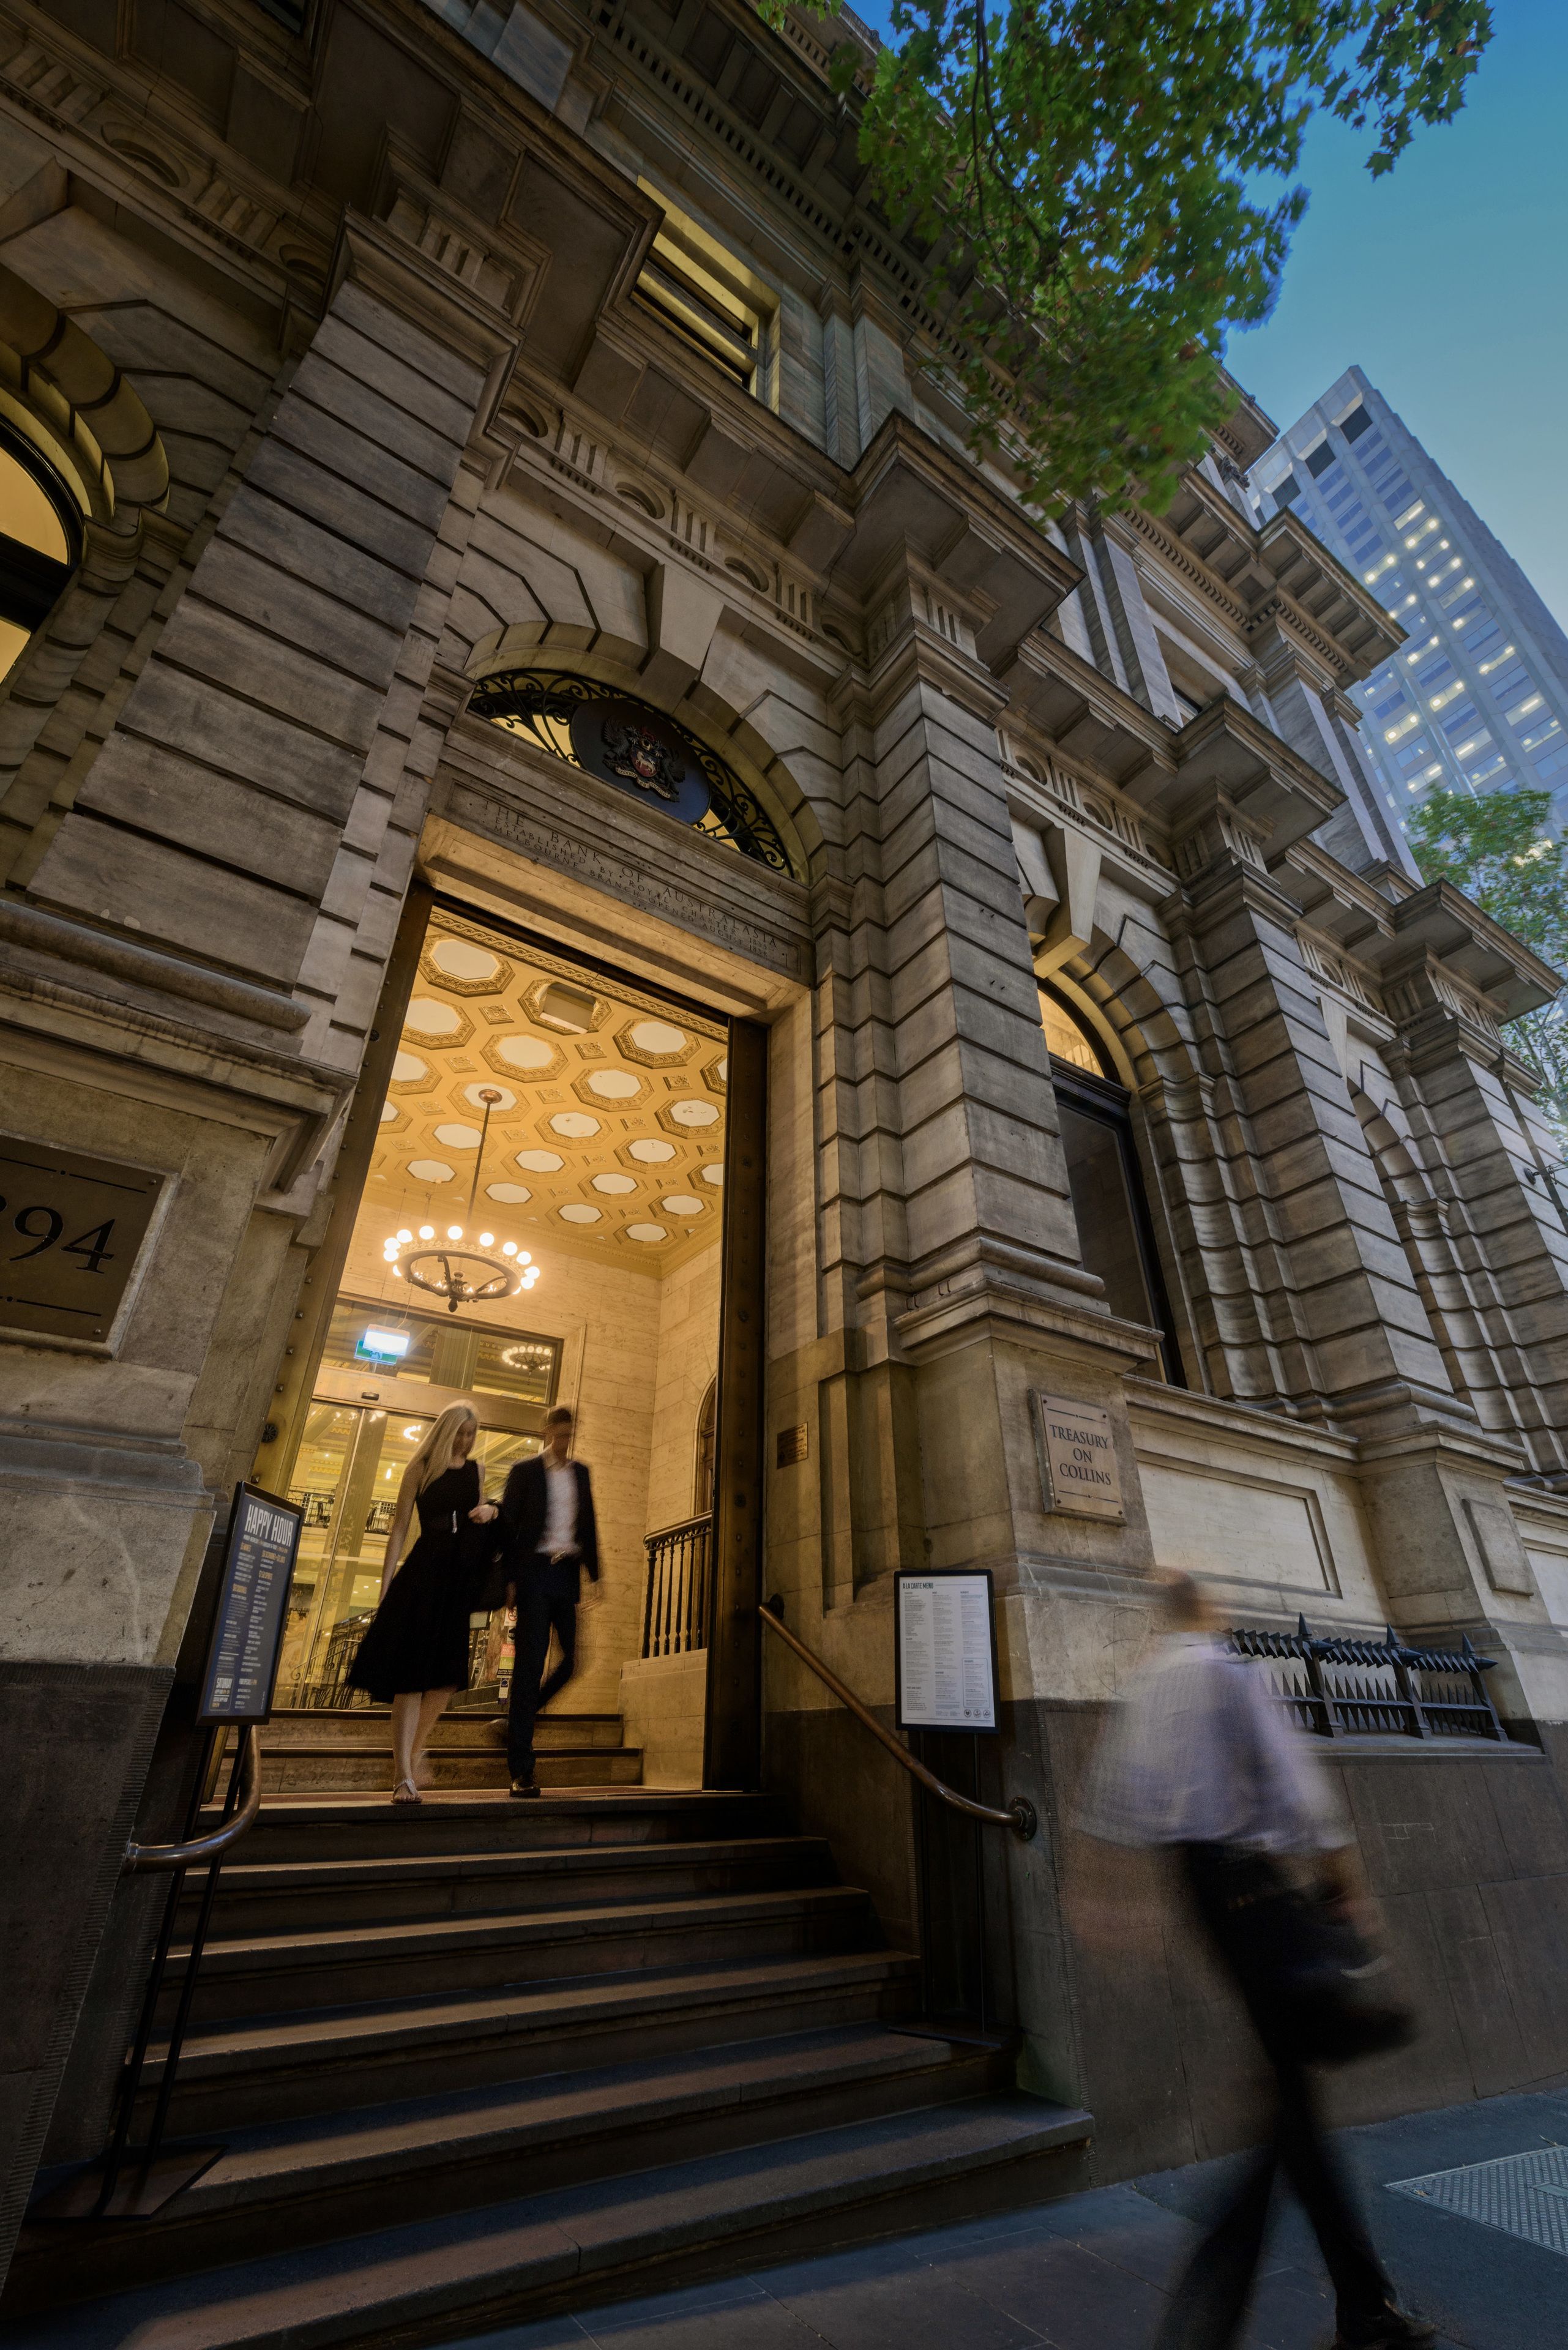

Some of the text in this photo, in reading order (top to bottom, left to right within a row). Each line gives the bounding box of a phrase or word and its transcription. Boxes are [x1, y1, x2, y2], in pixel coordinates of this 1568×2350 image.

[483, 799, 777, 947] THE BANK OF AUSTRALASIA
[493, 826, 578, 868] MELBOURNE
[589, 870, 640, 897] BRANCH
[648, 897, 695, 922] OPENED
[703, 923, 744, 946] AUGUST
[495, 817, 586, 864] ESTABLISHED
[600, 866, 613, 877] BY
[629, 879, 668, 903] ROYAL
[682, 906, 737, 936] CHARTER
[0, 1195, 116, 1274] 94
[1049, 1424, 1109, 1450] TREASURY
[1073, 1447, 1092, 1463] ON
[1059, 1463, 1111, 1485] COLLINS
[245, 1504, 273, 1540] HAPPY
[271, 1515, 294, 1547] HOUR
